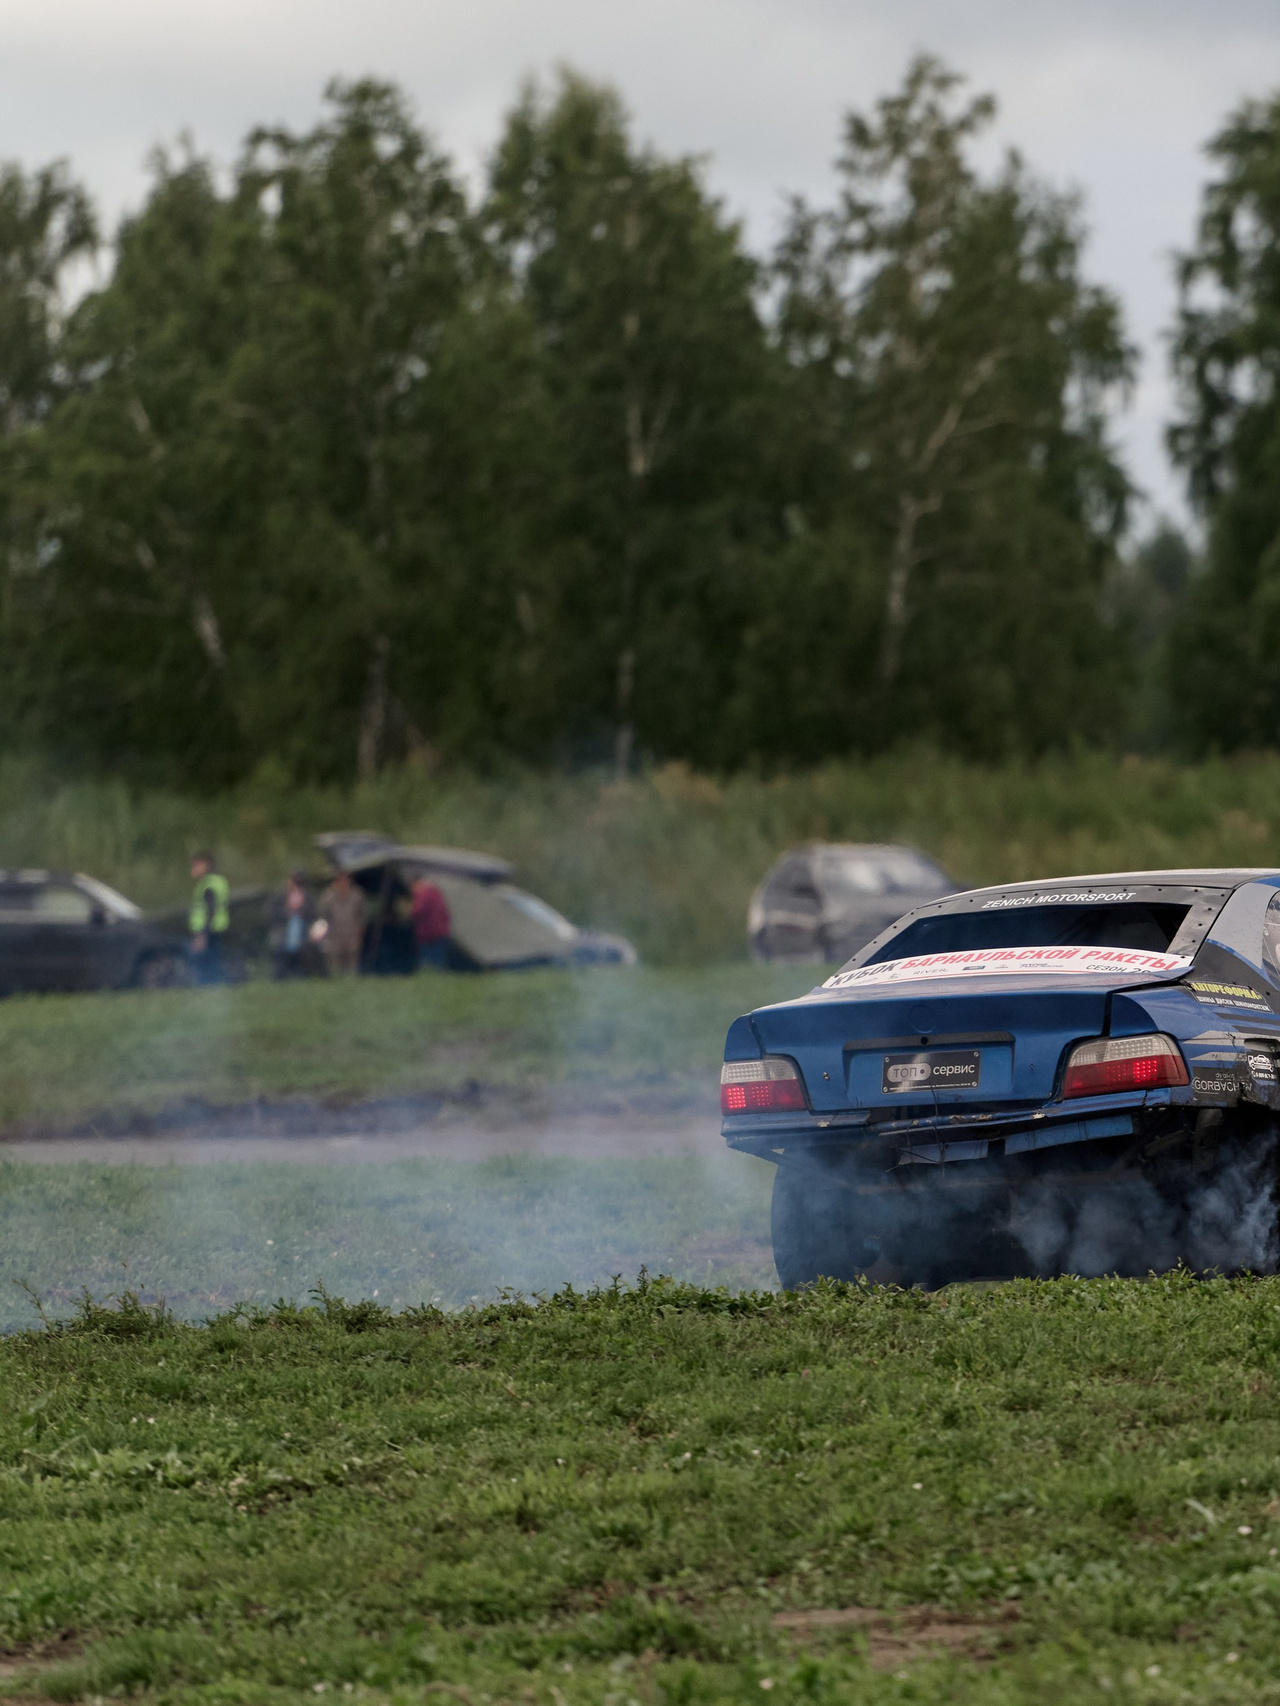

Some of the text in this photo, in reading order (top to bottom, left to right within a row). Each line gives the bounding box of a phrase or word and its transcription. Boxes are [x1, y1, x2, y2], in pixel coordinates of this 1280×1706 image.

[981, 892, 1136, 909] ZENICH MOTORSPORT
[829, 947, 1179, 988] КУБОК БАРНАУЛЬСКОЙ РАКЕТЫ
[1086, 964, 1127, 973] СЕЗОН
[893, 1064, 975, 1078] ТОП сервис
